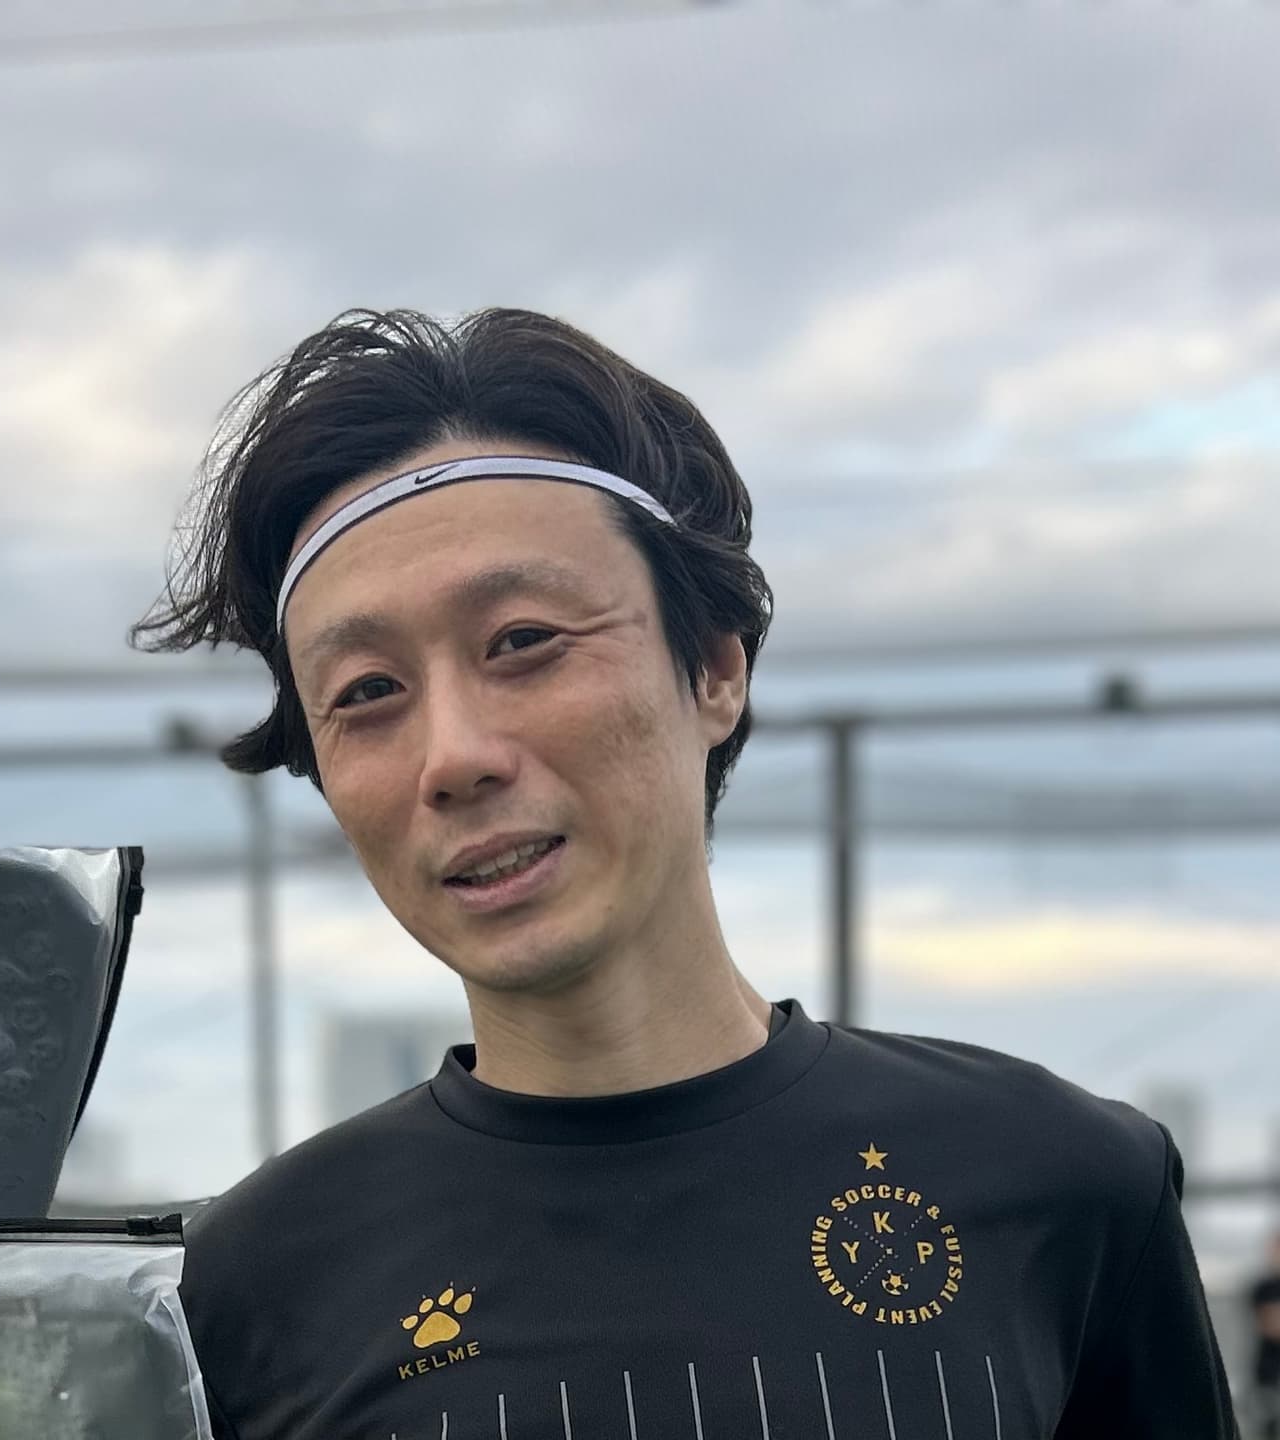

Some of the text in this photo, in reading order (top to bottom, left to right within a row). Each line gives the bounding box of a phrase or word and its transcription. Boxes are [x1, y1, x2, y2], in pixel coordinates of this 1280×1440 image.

[811, 1184, 963, 1325] SOCCER & FUTSAL EVENT PLANNING
[841, 1211, 934, 1264] Y K P
[398, 1341, 480, 1380] KELME
